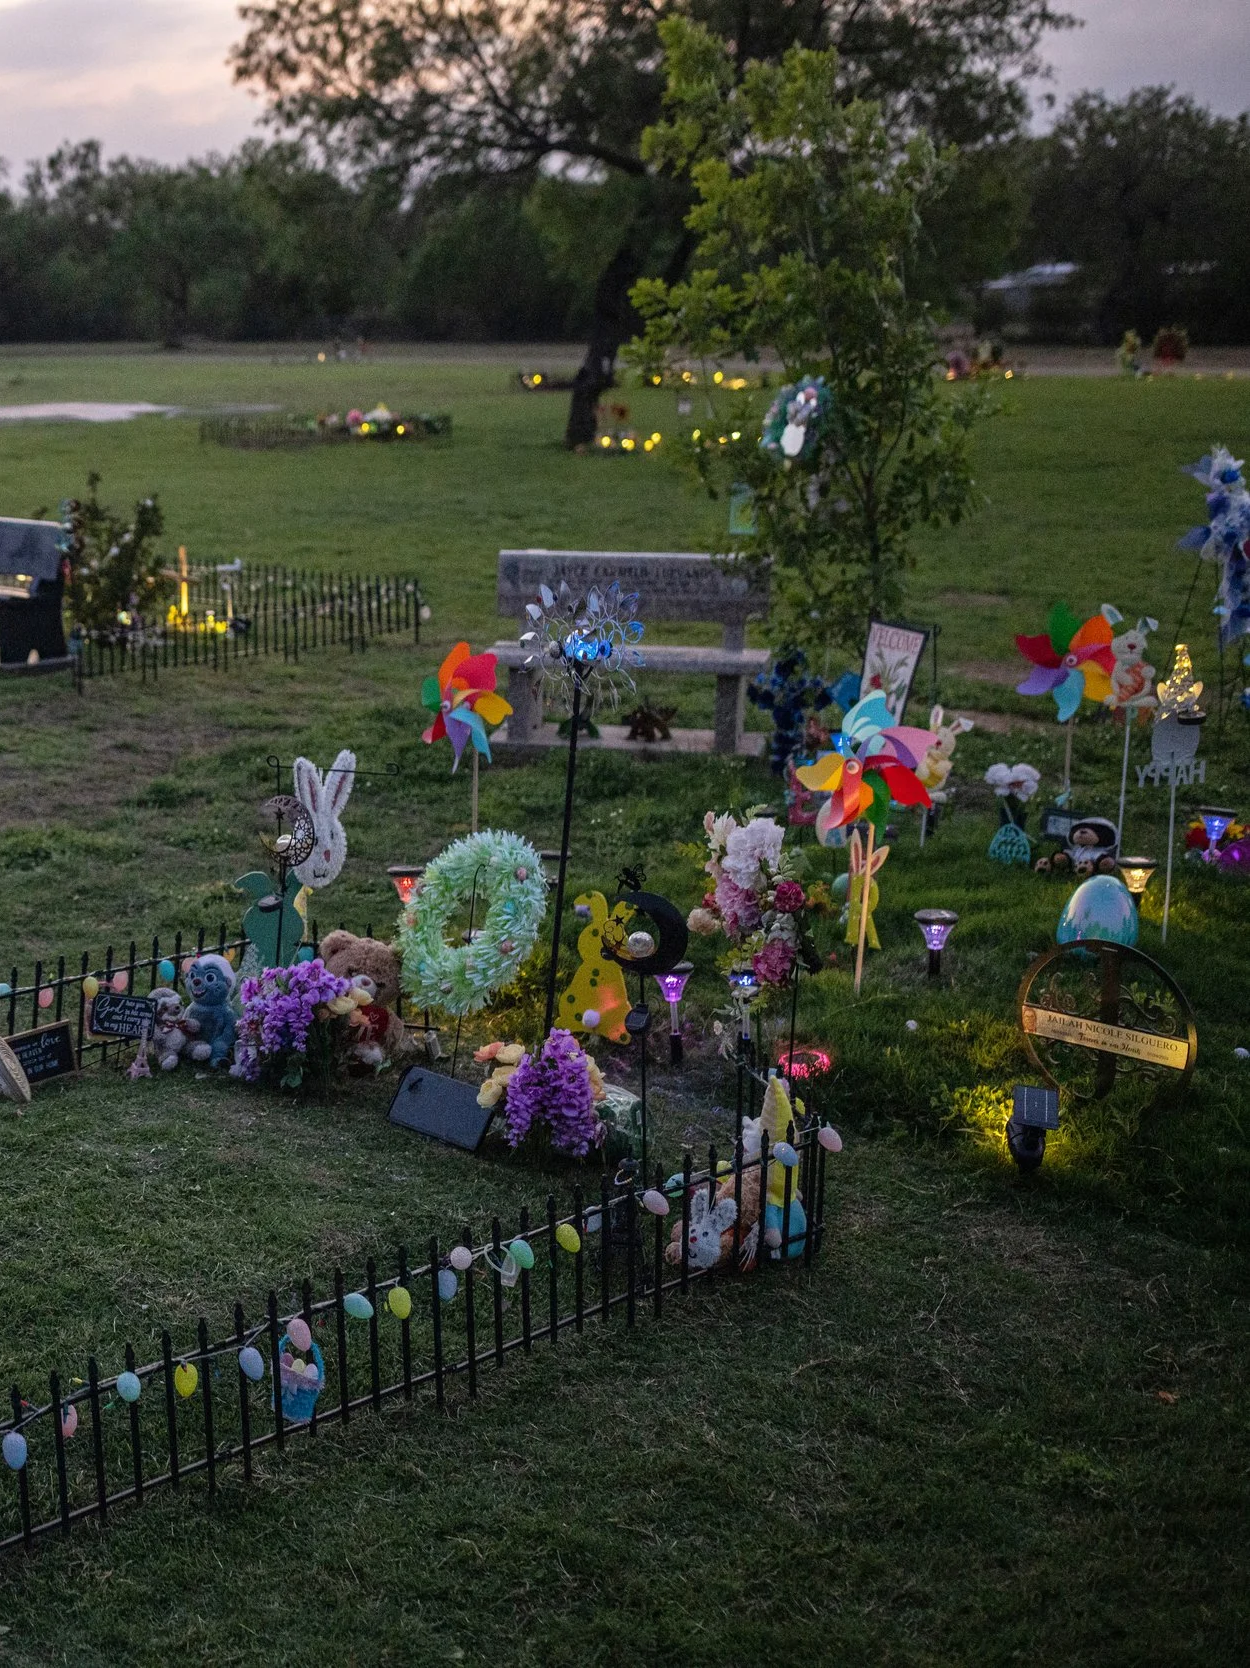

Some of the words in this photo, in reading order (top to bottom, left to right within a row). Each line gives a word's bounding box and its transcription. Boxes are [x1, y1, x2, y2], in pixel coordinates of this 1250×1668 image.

[97, 996, 125, 1018] God
[118, 1023, 144, 1034] HEAR
[1047, 1014, 1083, 1030] JAILAH
[1086, 1023, 1123, 1039] NICOLE
[1125, 1032, 1178, 1053] SILGUERO
